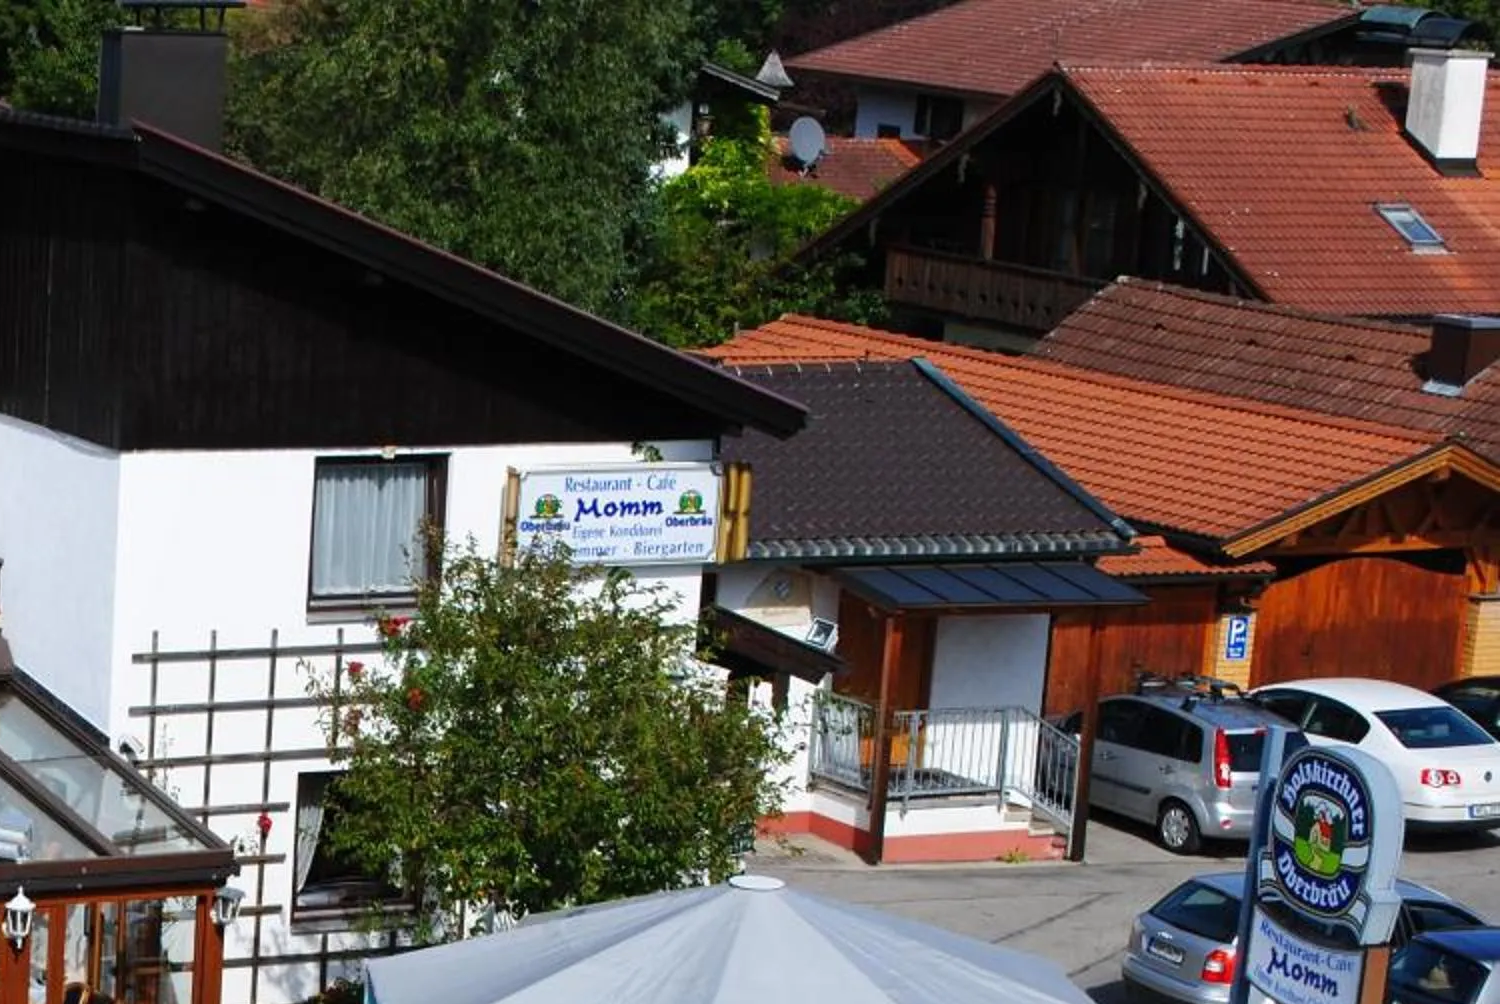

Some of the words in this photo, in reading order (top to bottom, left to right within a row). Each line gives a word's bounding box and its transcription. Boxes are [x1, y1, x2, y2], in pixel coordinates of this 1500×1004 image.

[564, 475, 633, 492] Restaurant
[573, 497, 664, 522] Momm
[633, 541, 705, 556] Biergarten
[1230, 619, 1246, 645] P
[1267, 946, 1338, 997] Momm
